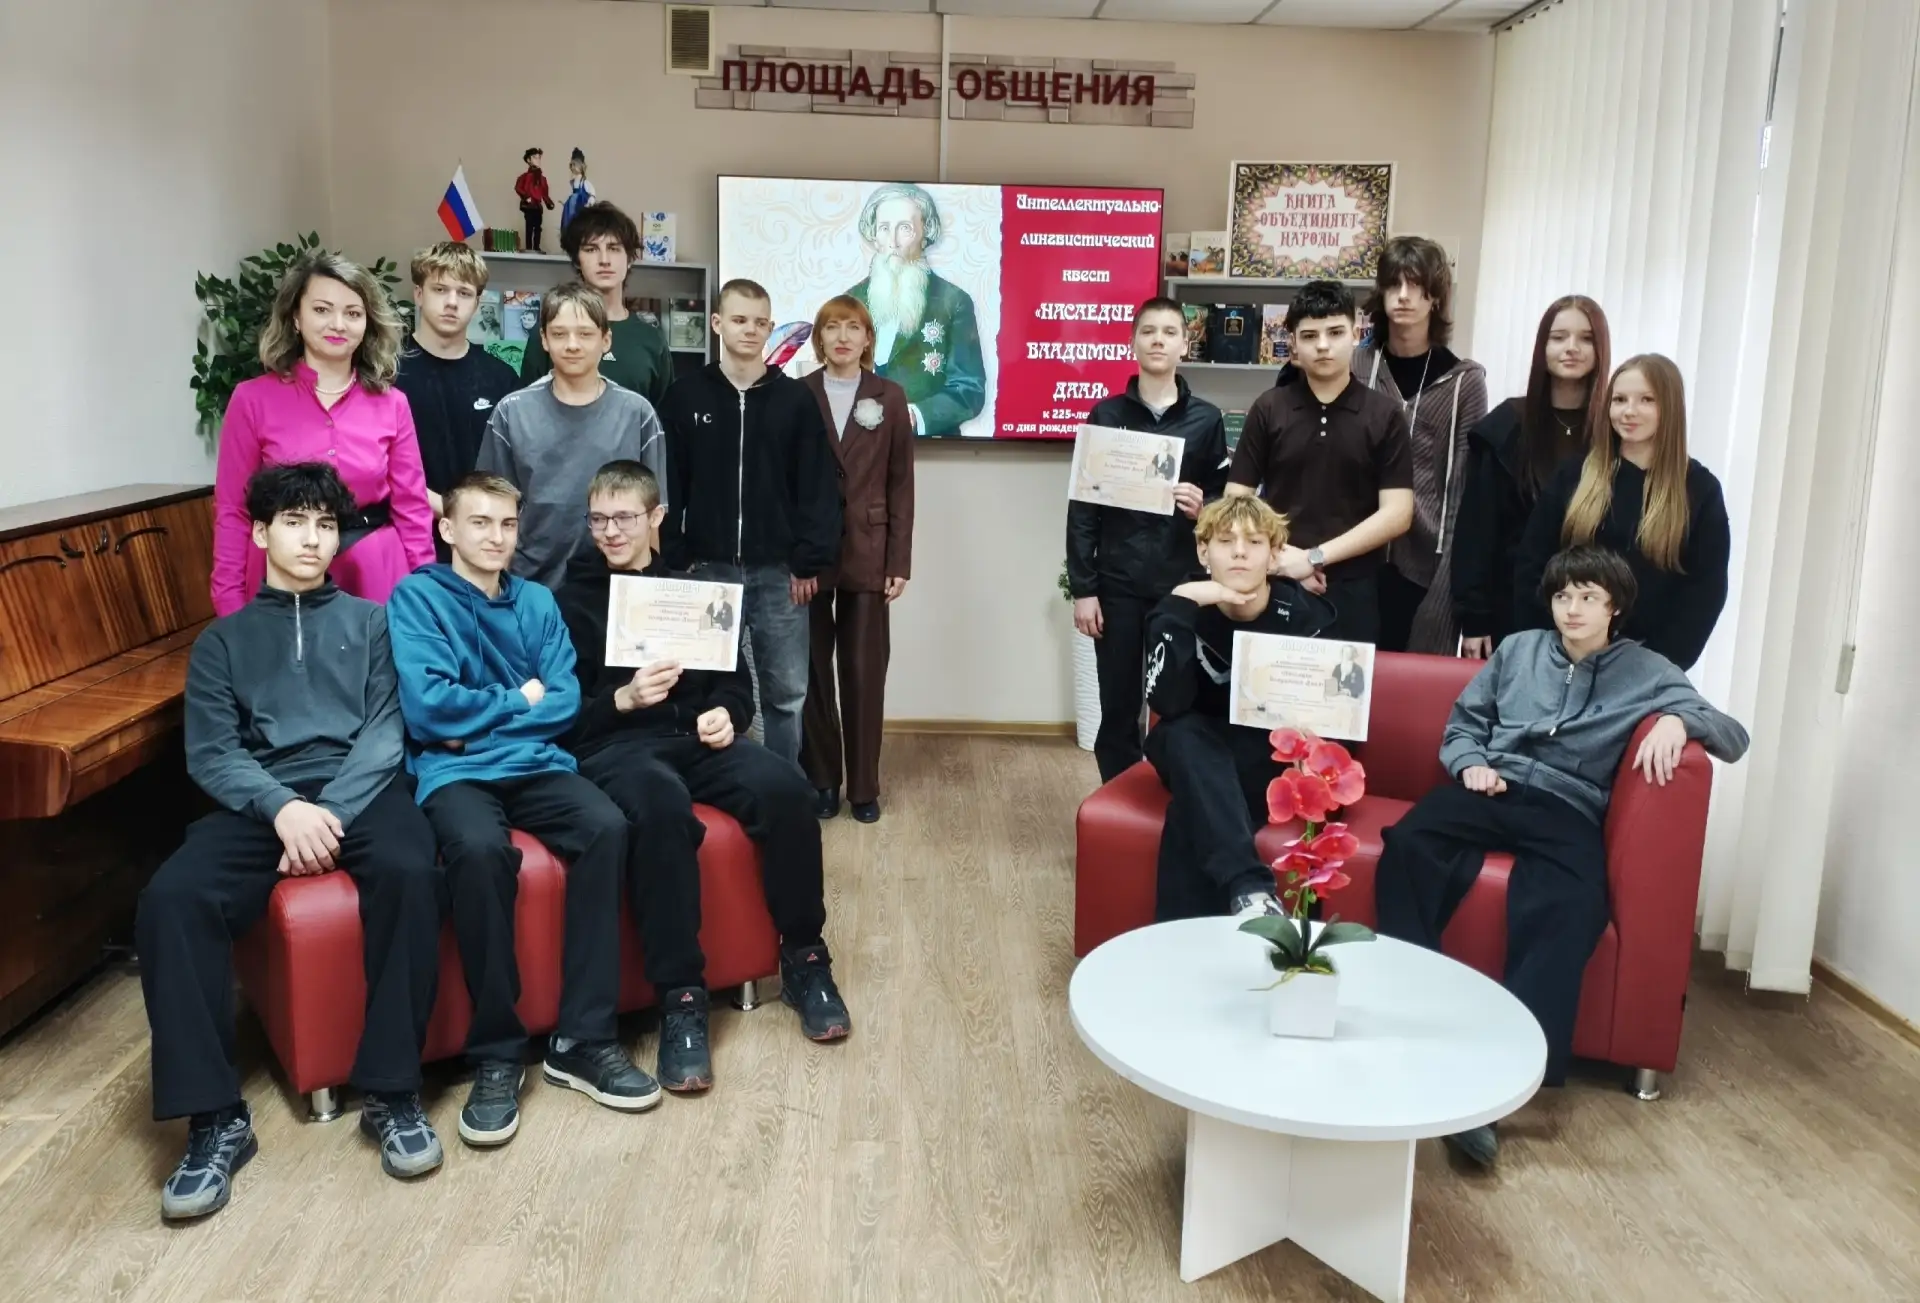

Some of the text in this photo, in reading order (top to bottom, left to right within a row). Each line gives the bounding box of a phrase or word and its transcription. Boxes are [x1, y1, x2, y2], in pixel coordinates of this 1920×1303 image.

[722, 59, 1156, 108] ПЛОЩАДЬ ОБЩЕНИЯ
[1016, 193, 1162, 215] Интеллектуально-
[1284, 193, 1336, 209] КНИГА
[1260, 212, 1358, 229] ОБЪЕДИНЯЕТ
[1020, 232, 1155, 248] лингвистический
[1280, 231, 1340, 248] НАРОДЫ
[1062, 269, 1110, 283] квест
[1035, 302, 1135, 325] «НАСЛЕДИЕ
[1052, 381, 1109, 402] ДАЛЯ»
[1042, 410, 1050, 419] к
[1002, 423, 1014, 432] со
[1016, 423, 1037, 433] дня
